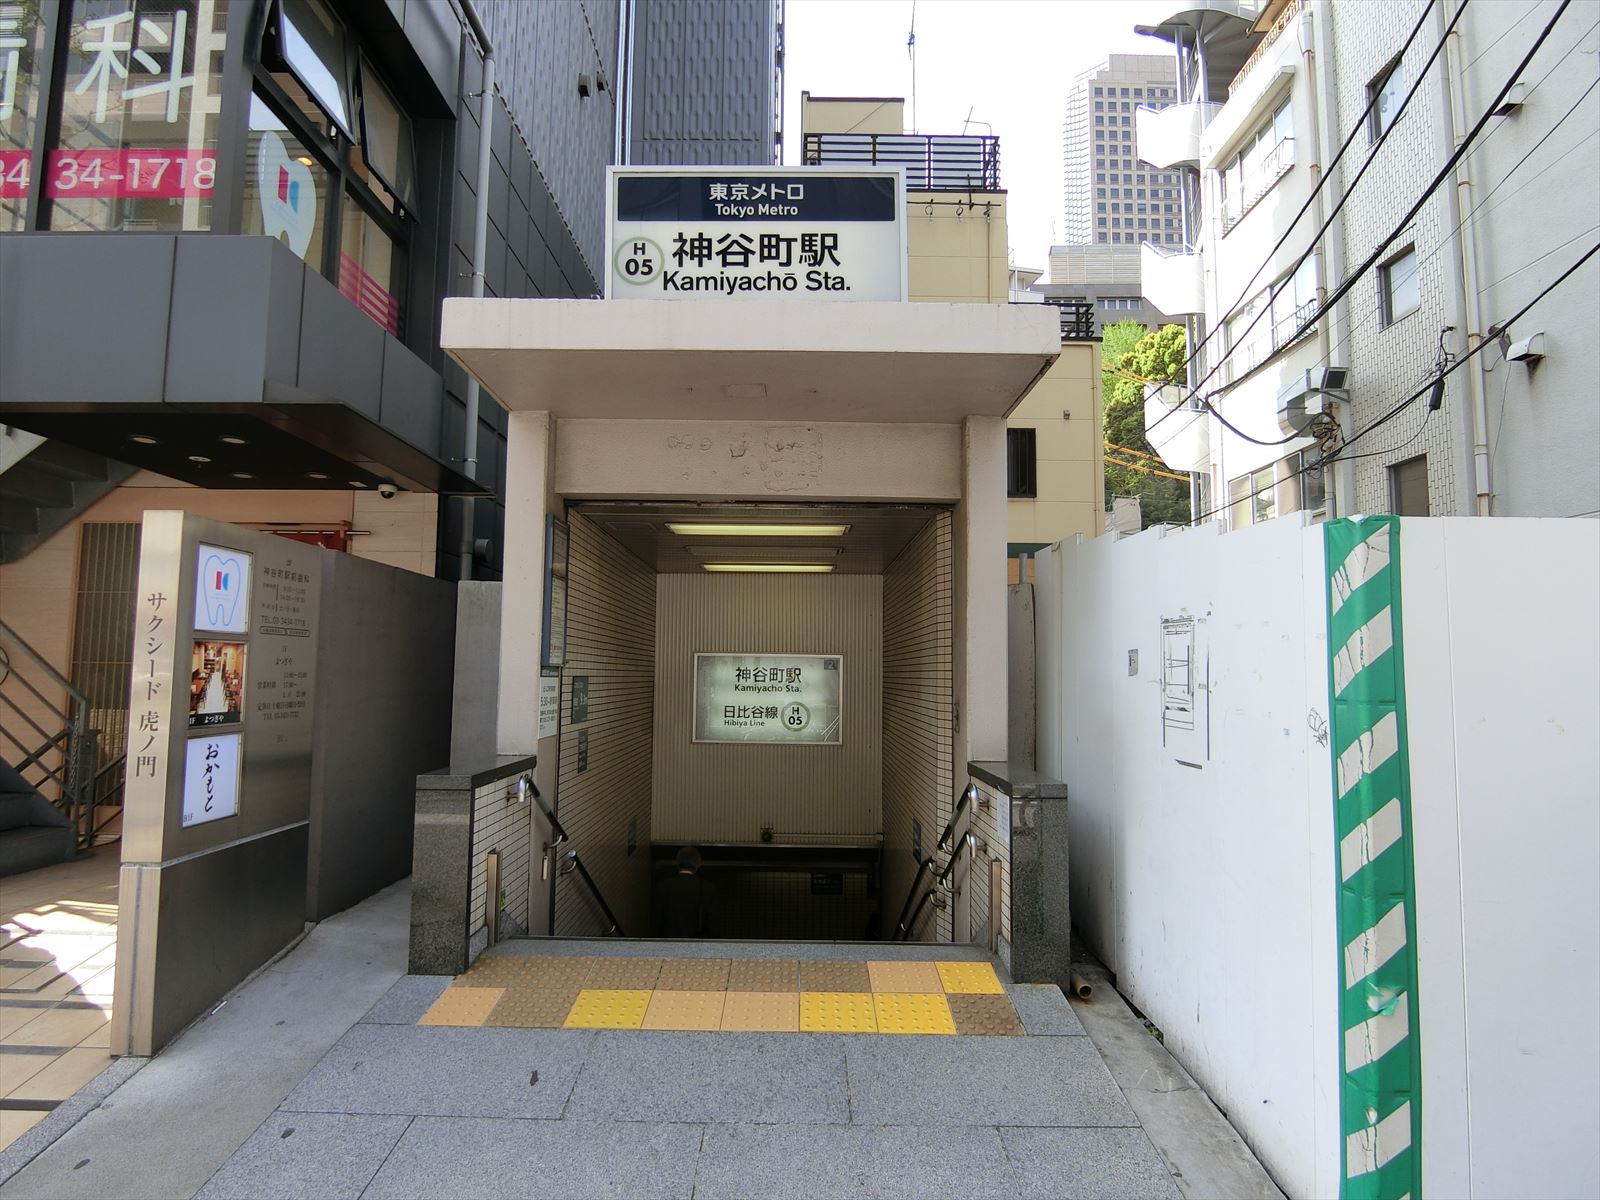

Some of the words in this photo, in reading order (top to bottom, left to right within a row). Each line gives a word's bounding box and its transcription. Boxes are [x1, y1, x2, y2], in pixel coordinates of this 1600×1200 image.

[709, 183, 804, 201] 東京メトロ
[714, 203, 755, 218] Tokyo
[758, 203, 798, 216] Metro
[633, 243, 646, 255] H
[672, 232, 841, 268] 神谷町駅
[625, 258, 654, 276] 05
[663, 271, 798, 295] Kamiyachō
[805, 271, 851, 291] Sta.
[147, 592, 167, 701] サクシード
[735, 666, 802, 684] 神谷町駅
[734, 684, 783, 694] Kamiyacho
[785, 684, 802, 693] Sta.
[724, 705, 778, 719] 日比谷線
[791, 707, 800, 715] H
[724, 719, 748, 727] Hibiya
[750, 719, 765, 727] Line
[788, 716, 803, 726] 05
[136, 711, 159, 777] 虎ノ門
[202, 743, 220, 813] おかもと
